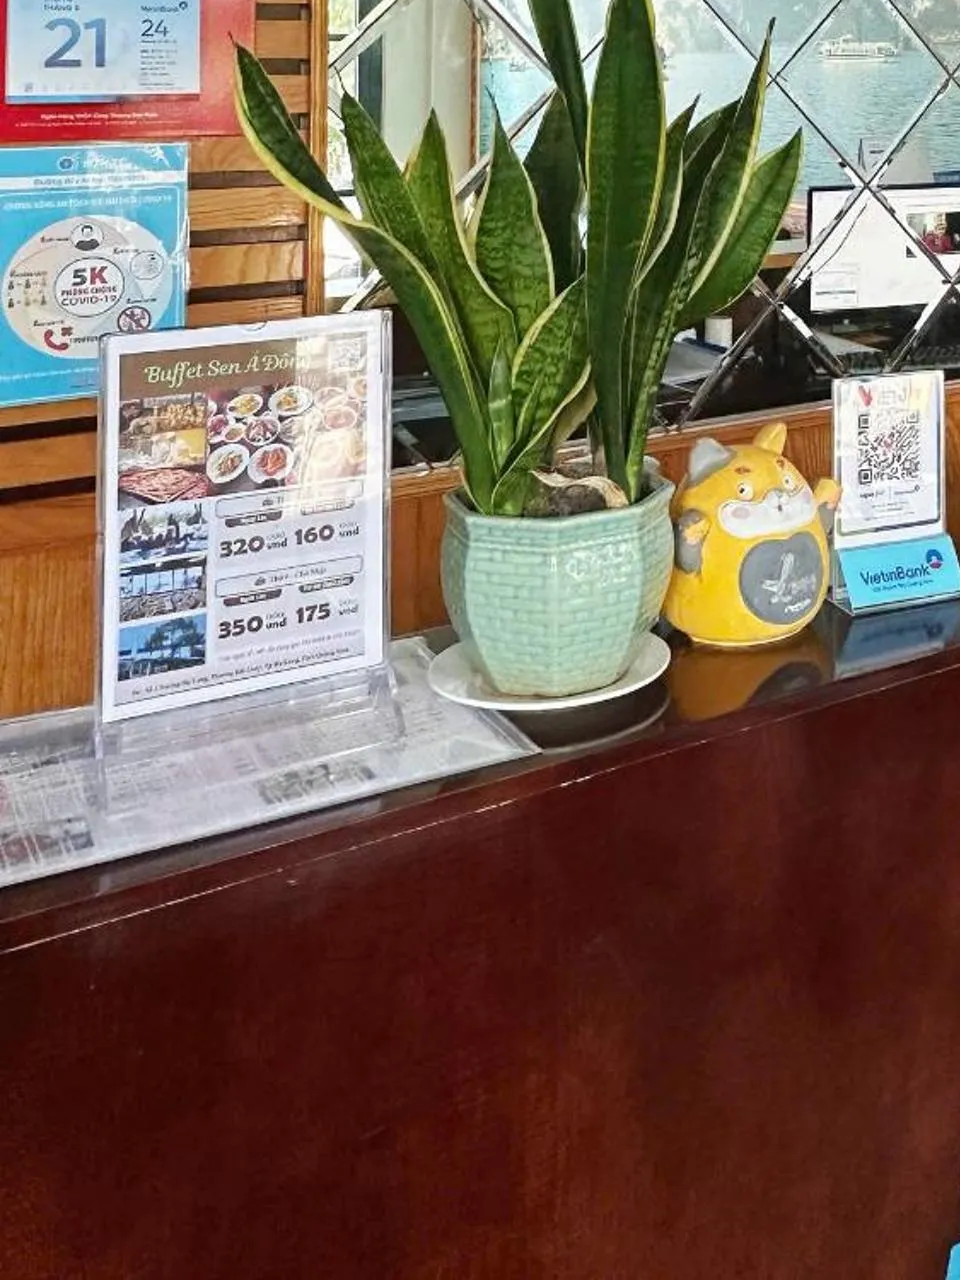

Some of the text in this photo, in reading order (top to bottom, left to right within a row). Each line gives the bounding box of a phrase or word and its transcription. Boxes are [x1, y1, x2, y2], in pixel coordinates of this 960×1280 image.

[140, 19, 169, 37] 24
[44, 18, 107, 68] 21
[71, 265, 109, 287] 5K
[144, 361, 203, 389] Buffet
[207, 359, 243, 377] Sen
[219, 535, 265, 558] 320
[294, 524, 335, 546] 160
[859, 563, 931, 586] VietinBank
[296, 603, 331, 624] 175
[217, 614, 264, 639] 350
